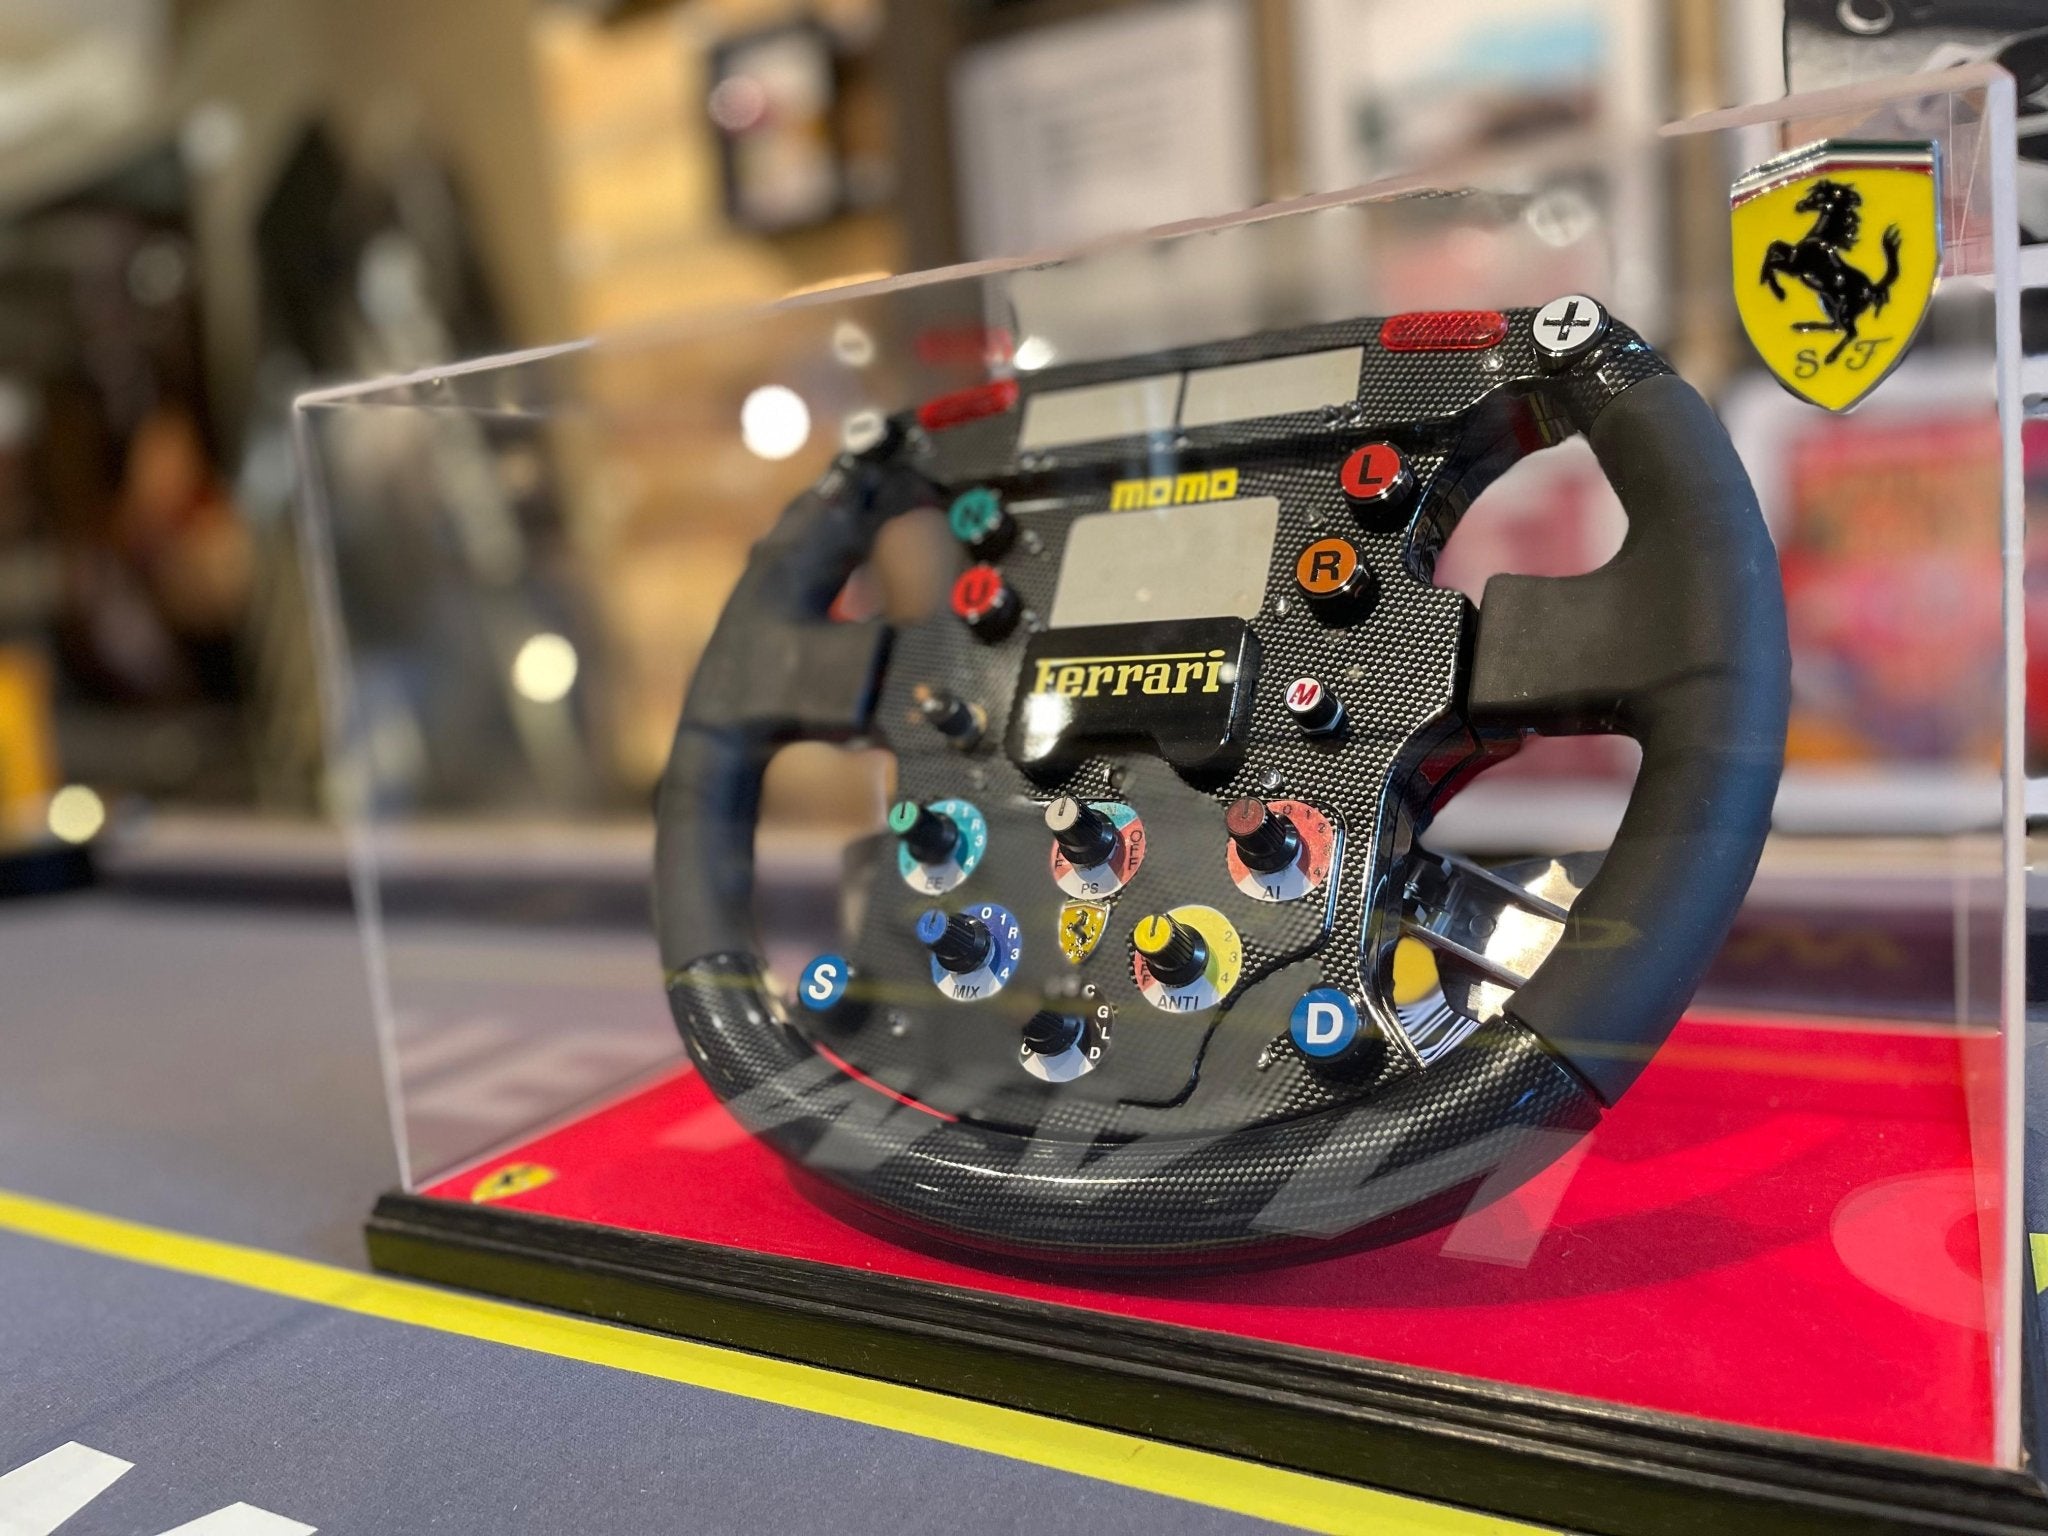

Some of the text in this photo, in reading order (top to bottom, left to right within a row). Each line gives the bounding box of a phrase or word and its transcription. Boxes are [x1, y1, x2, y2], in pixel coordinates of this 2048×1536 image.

[1358, 454, 1383, 485] L
[1310, 550, 1341, 582] R
[1034, 649, 1226, 698] Ferrari
[1288, 683, 1319, 706] M
[1081, 882, 1099, 895] PS
[1008, 926, 1018, 939] R
[1010, 948, 1020, 960] 3
[1221, 930, 1238, 983] 2 3 4
[1000, 967, 1010, 979] 4
[808, 963, 837, 1000] S
[952, 984, 980, 999] MIX
[1157, 995, 1199, 1010] ANTI
[1097, 1005, 1109, 1018] G
[1306, 1002, 1344, 1044] D
[1101, 1027, 1110, 1040] L
[1089, 1046, 1101, 1059] D
